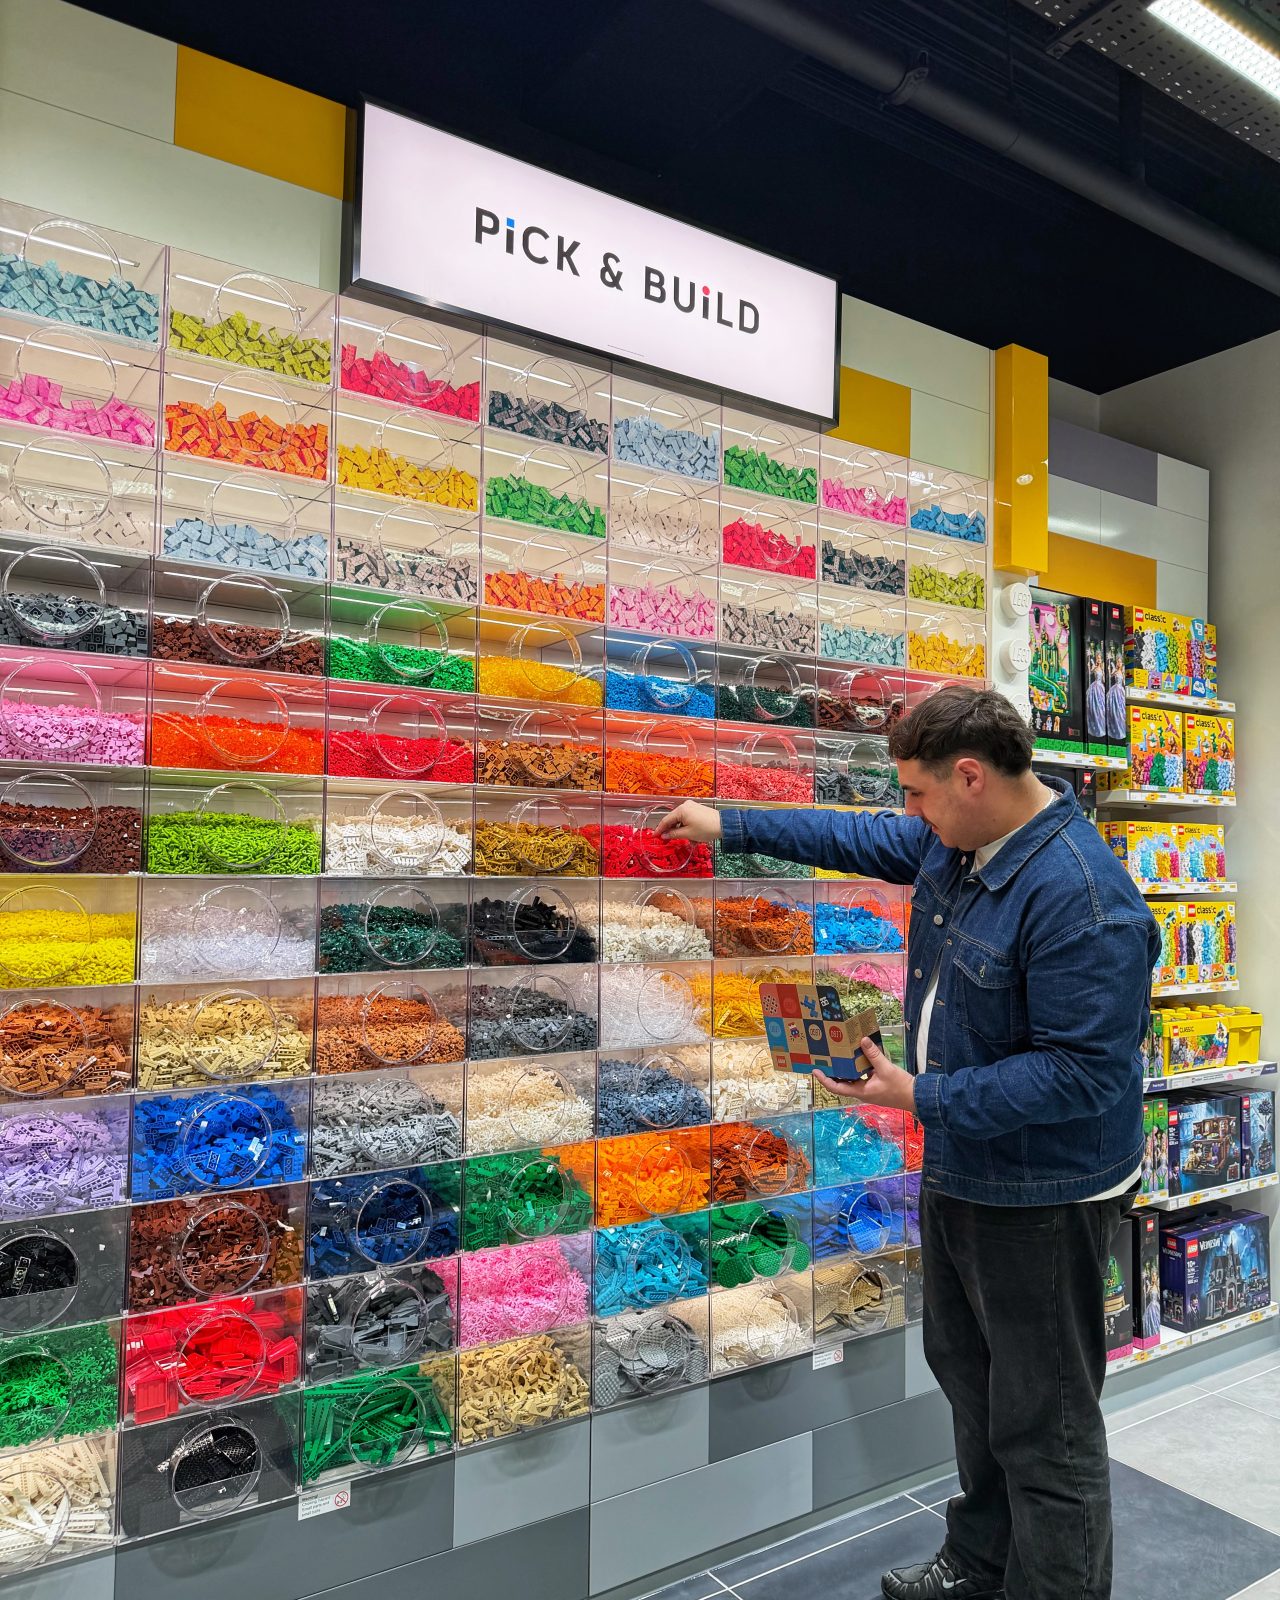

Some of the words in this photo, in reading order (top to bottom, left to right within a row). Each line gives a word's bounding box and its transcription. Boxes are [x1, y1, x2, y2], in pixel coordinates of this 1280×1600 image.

[600, 252, 624, 291] &
[1145, 612, 1167, 623] classic
[1141, 711, 1162, 722] classic
[1196, 719, 1215, 729] classic
[1184, 826, 1201, 834] classic
[1151, 906, 1167, 915] assic
[1196, 905, 1217, 914] classic
